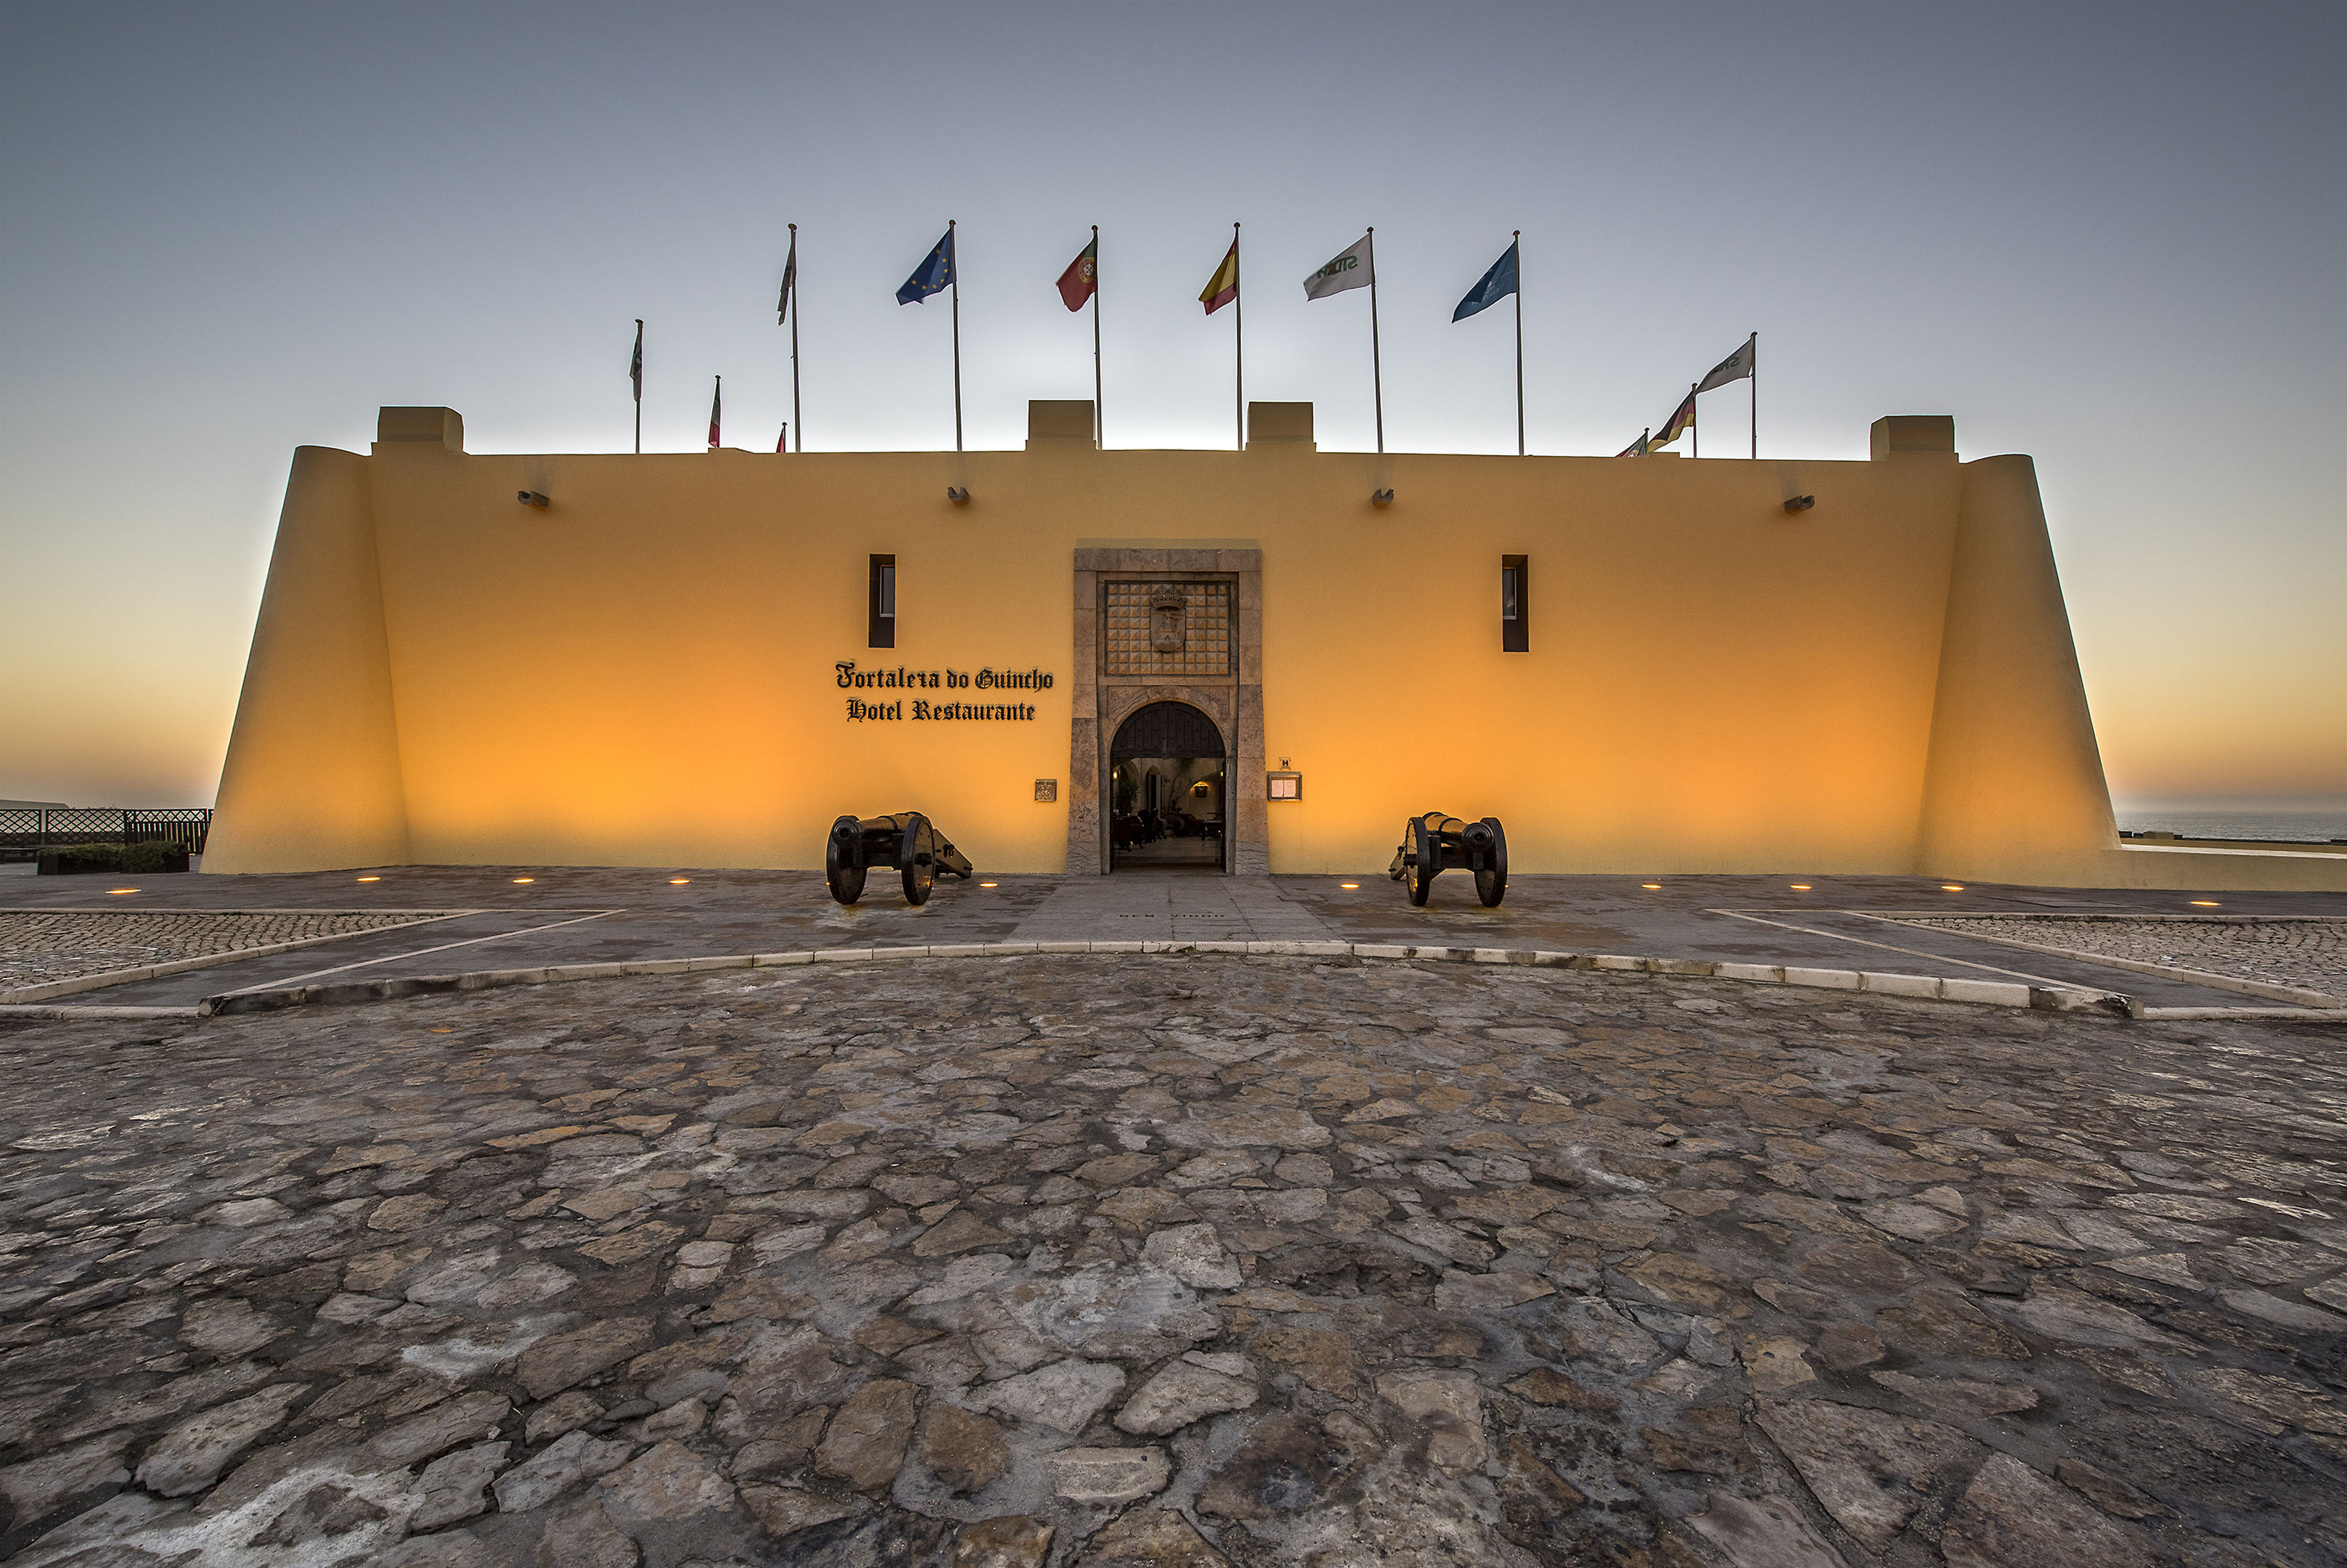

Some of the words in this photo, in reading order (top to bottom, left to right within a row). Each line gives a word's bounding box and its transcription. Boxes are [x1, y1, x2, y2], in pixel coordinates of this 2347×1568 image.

[946, 667, 969, 689] do
[974, 667, 1053, 693] Guincho
[846, 698, 903, 723] Hotel
[910, 698, 1036, 722] Restaurante
